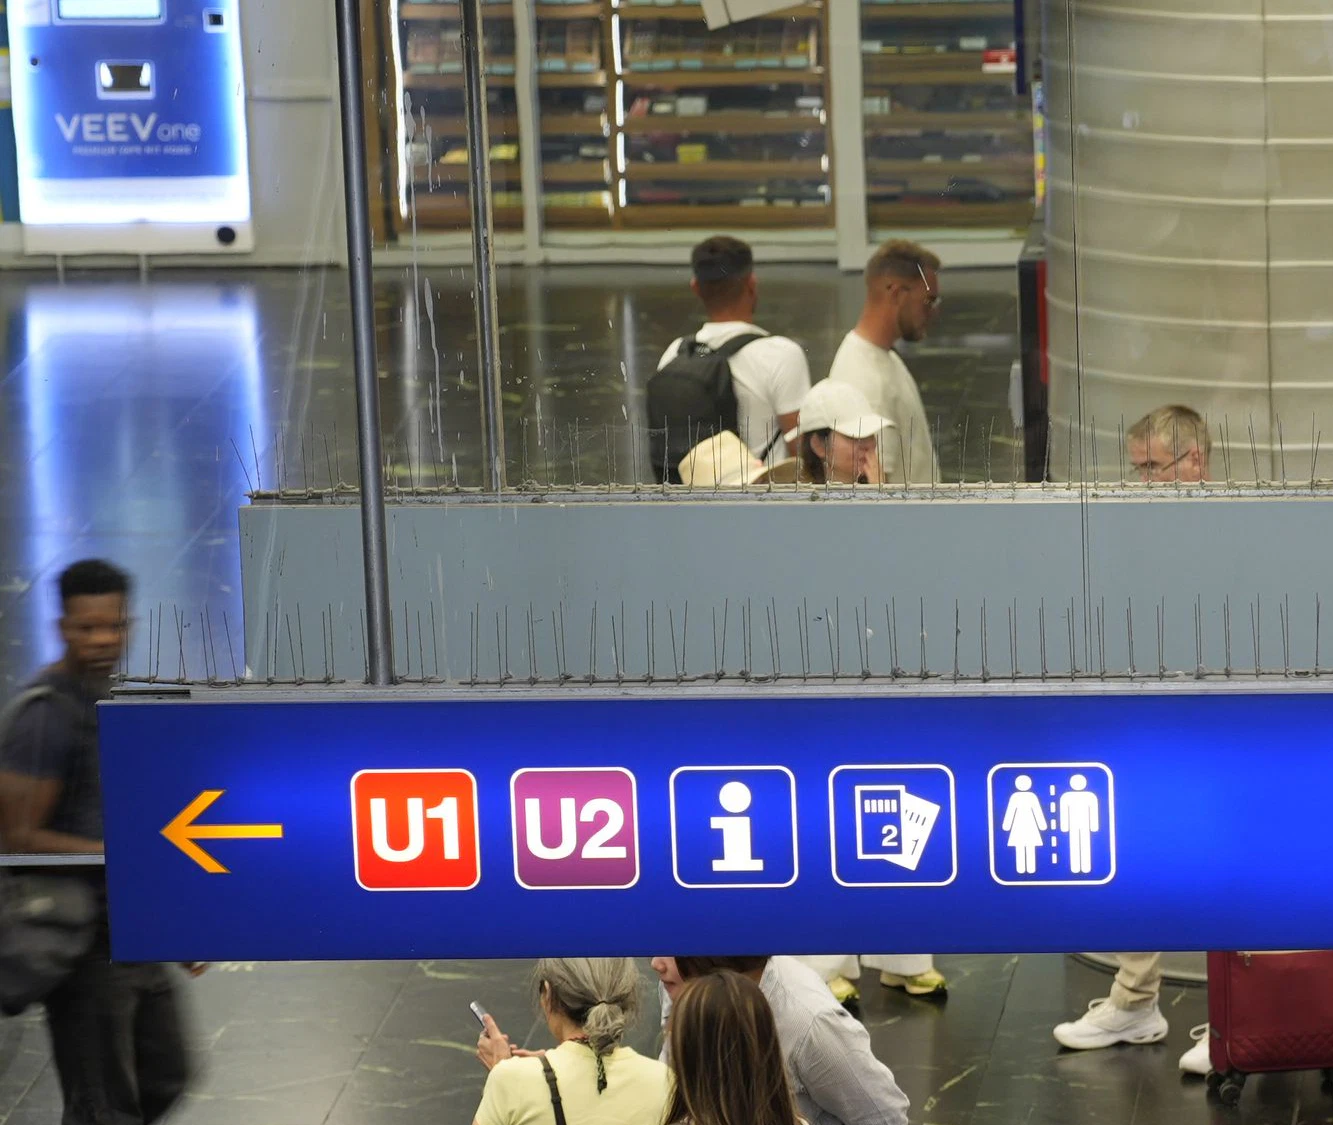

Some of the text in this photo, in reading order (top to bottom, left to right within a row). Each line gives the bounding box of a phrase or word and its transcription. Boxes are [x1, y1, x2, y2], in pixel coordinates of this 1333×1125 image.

[55, 113, 158, 142] VEEV
[370, 796, 460, 862] U1
[525, 797, 627, 861] U2
